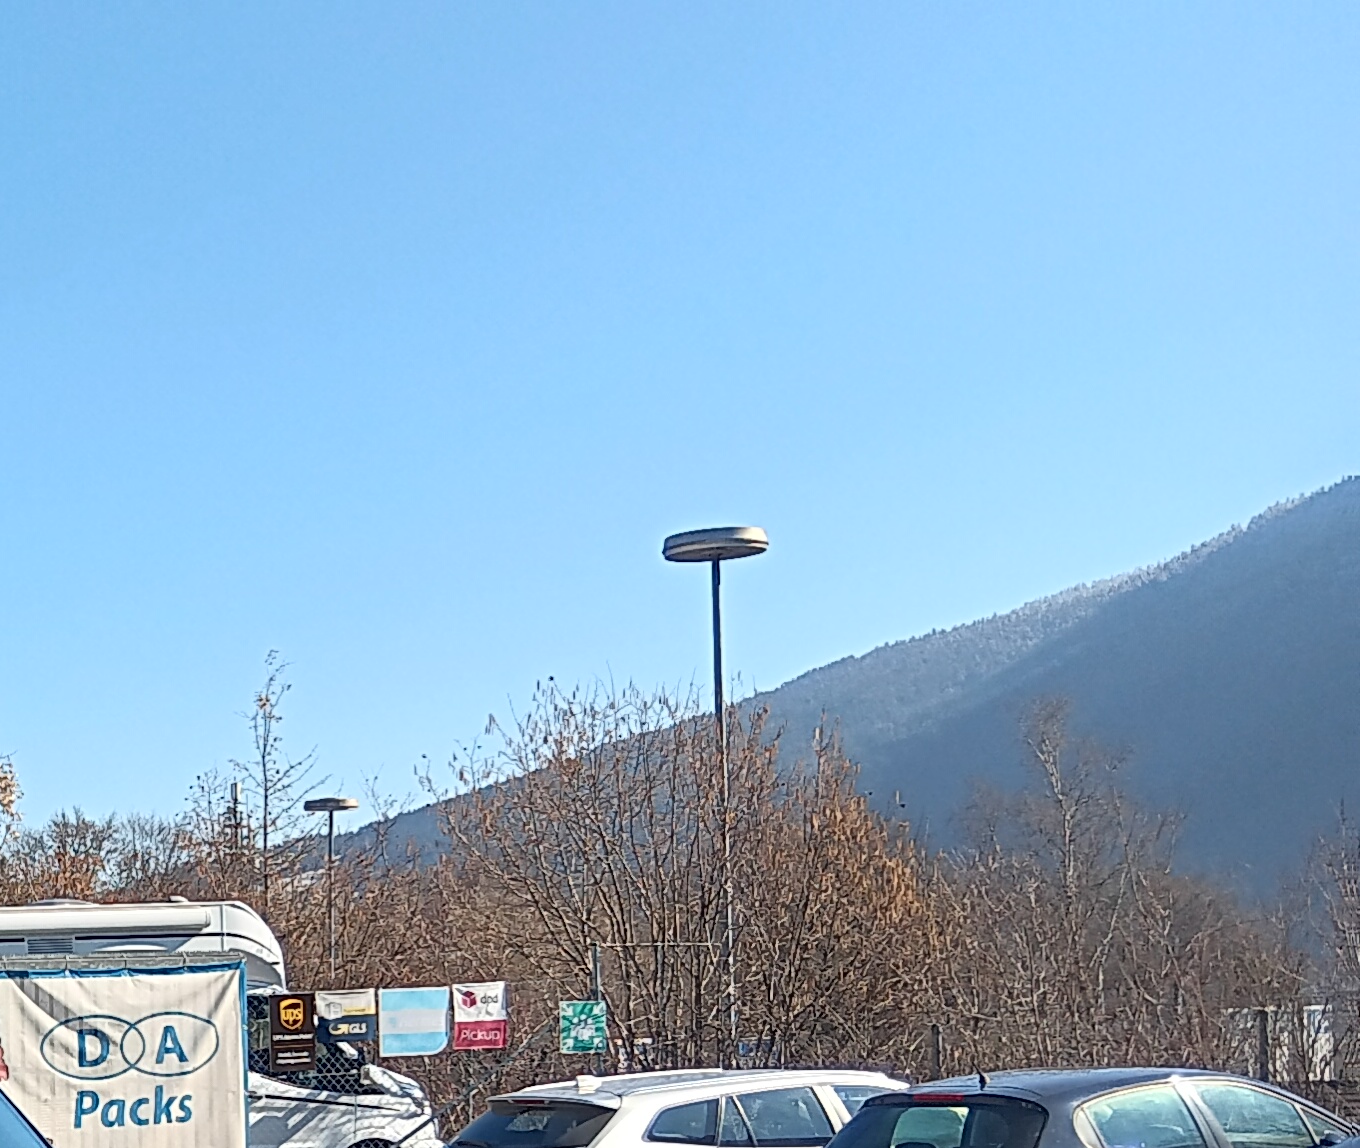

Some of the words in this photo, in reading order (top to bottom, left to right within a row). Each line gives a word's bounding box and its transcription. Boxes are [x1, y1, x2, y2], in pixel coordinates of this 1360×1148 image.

[480, 993, 499, 1005] dpd
[282, 1008, 302, 1025] ups
[460, 1028, 501, 1042] Pickup
[77, 1028, 110, 1068] D
[155, 1025, 189, 1064] A
[73, 1085, 193, 1129] Packs
